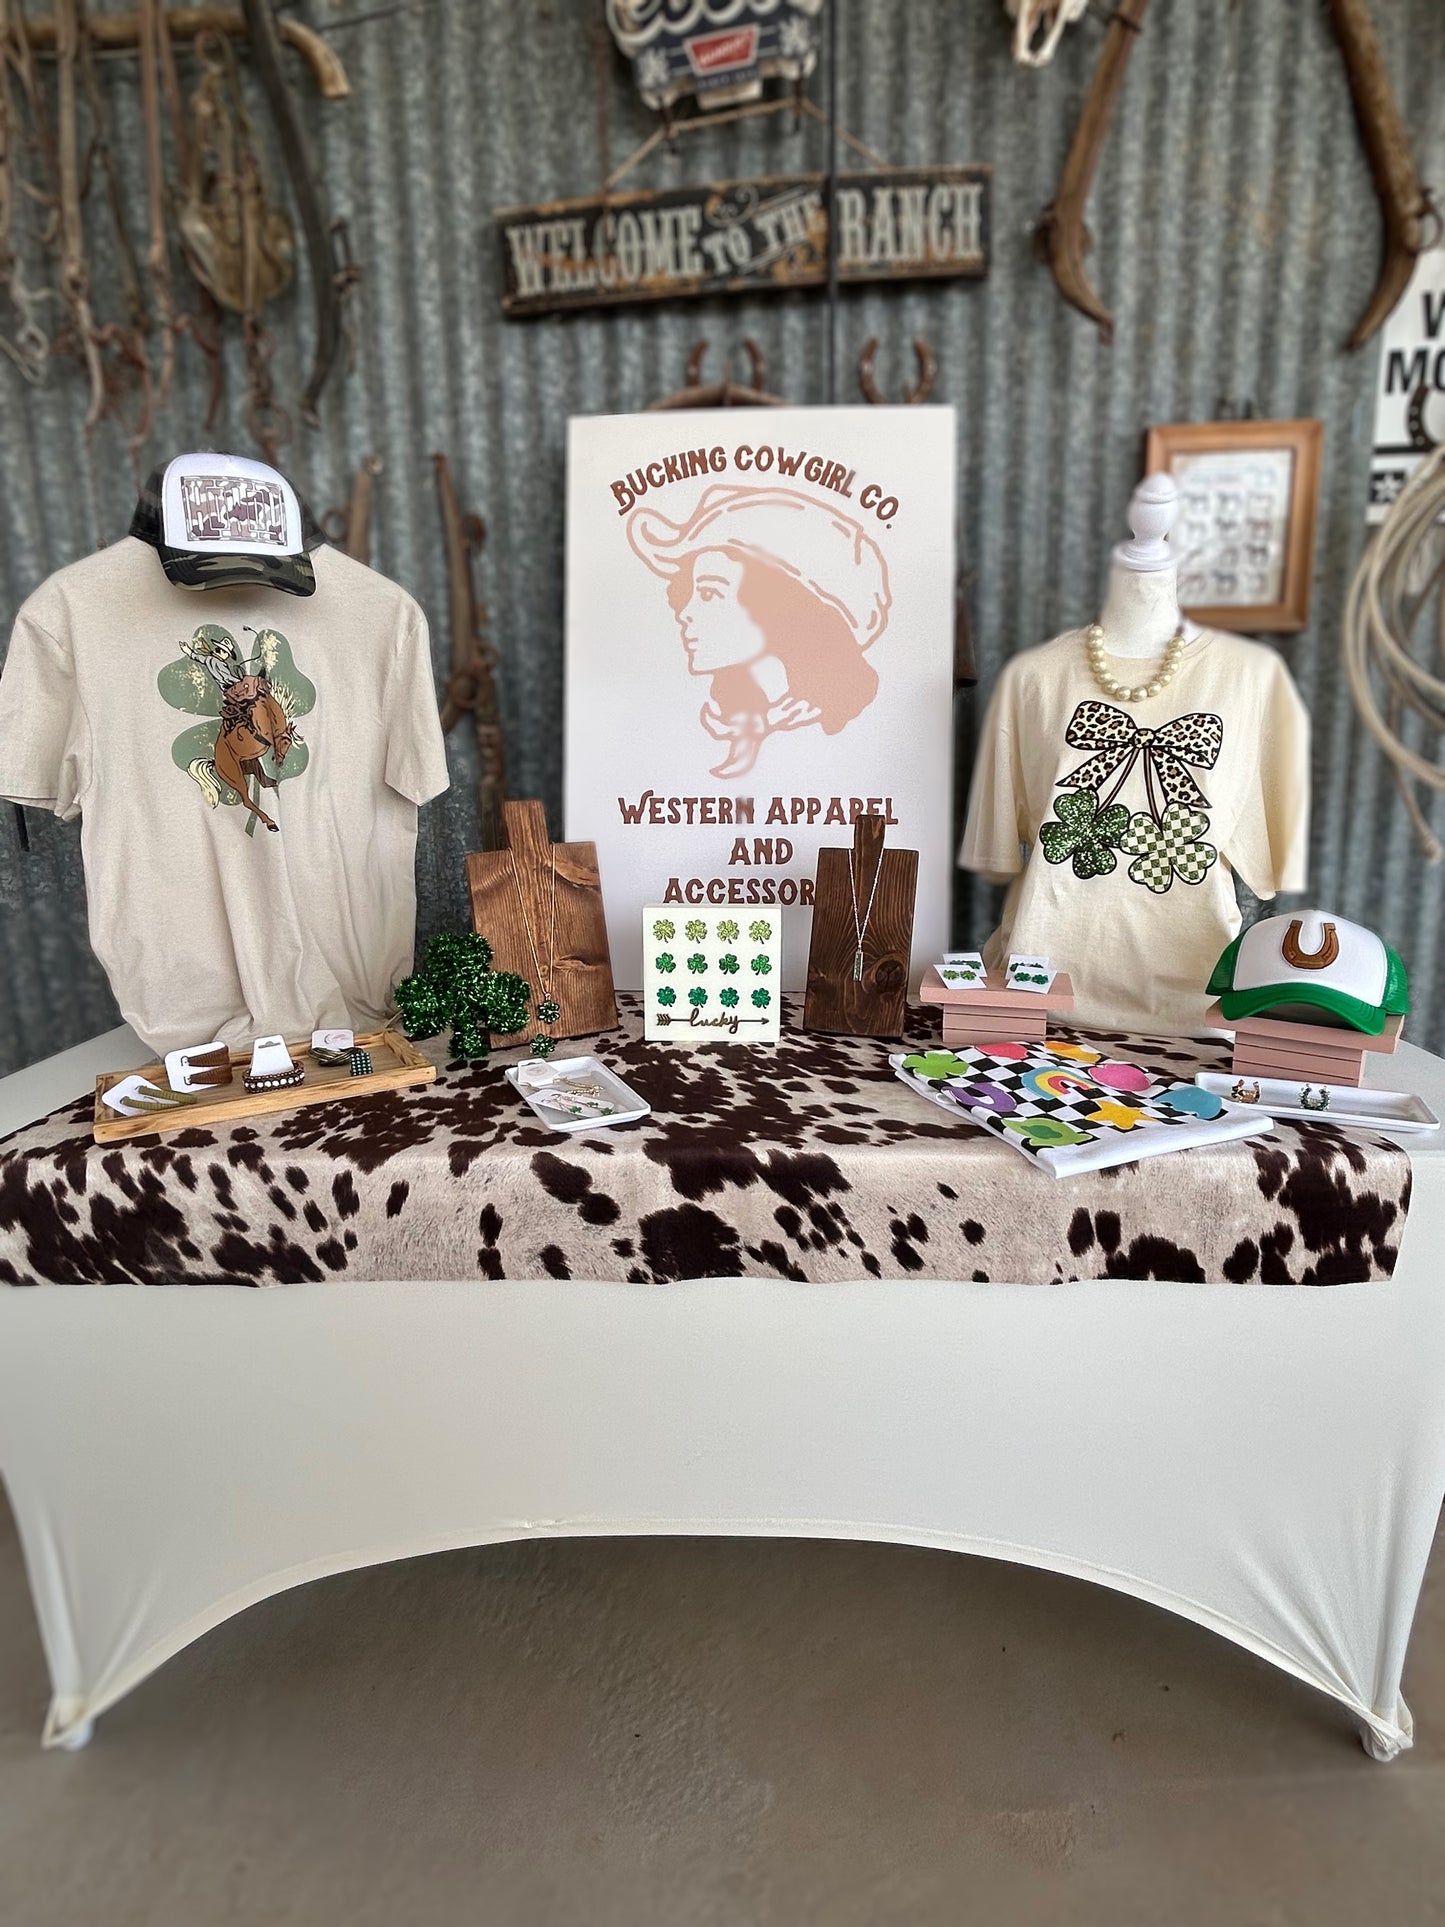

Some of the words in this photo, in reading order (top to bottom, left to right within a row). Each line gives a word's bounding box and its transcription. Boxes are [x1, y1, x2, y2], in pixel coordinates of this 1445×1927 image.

[507, 206, 701, 298] WELCOME
[702, 226, 752, 276] TO
[755, 190, 822, 252] THE
[837, 183, 985, 263] RANCH
[610, 446, 727, 516] BUCKING
[733, 445, 857, 498] COWGIRL
[859, 484, 899, 530] CO.
[617, 790, 755, 825] WESTERN
[764, 797, 899, 826] APPAREL
[728, 838, 794, 866] AND
[662, 878, 816, 906] ACCESSOR
[690, 1007, 739, 1035] lucky
